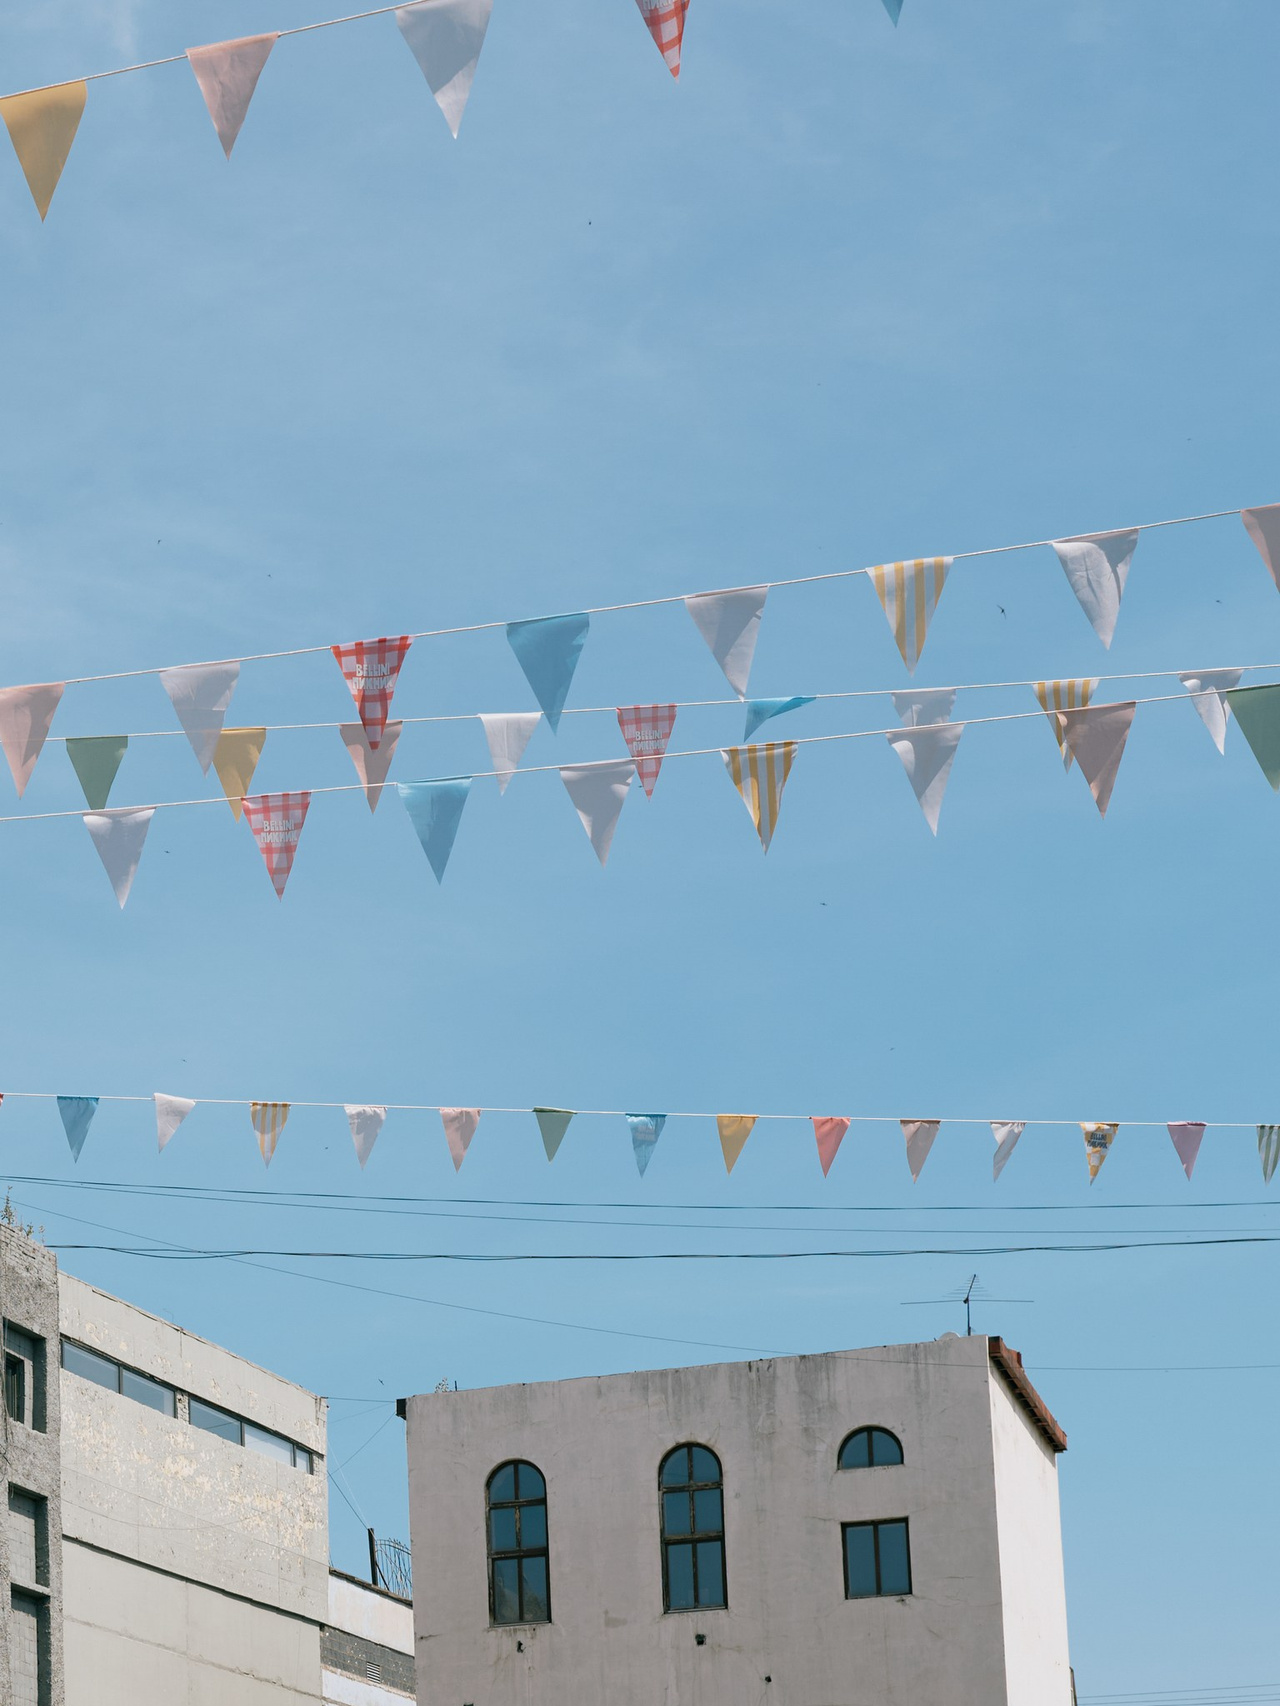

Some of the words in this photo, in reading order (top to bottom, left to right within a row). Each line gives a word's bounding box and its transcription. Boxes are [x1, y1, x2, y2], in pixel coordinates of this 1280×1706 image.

[356, 663, 390, 676] BELLINI
[635, 730, 663, 741] BELLINI
[263, 820, 294, 832] BELLINI
